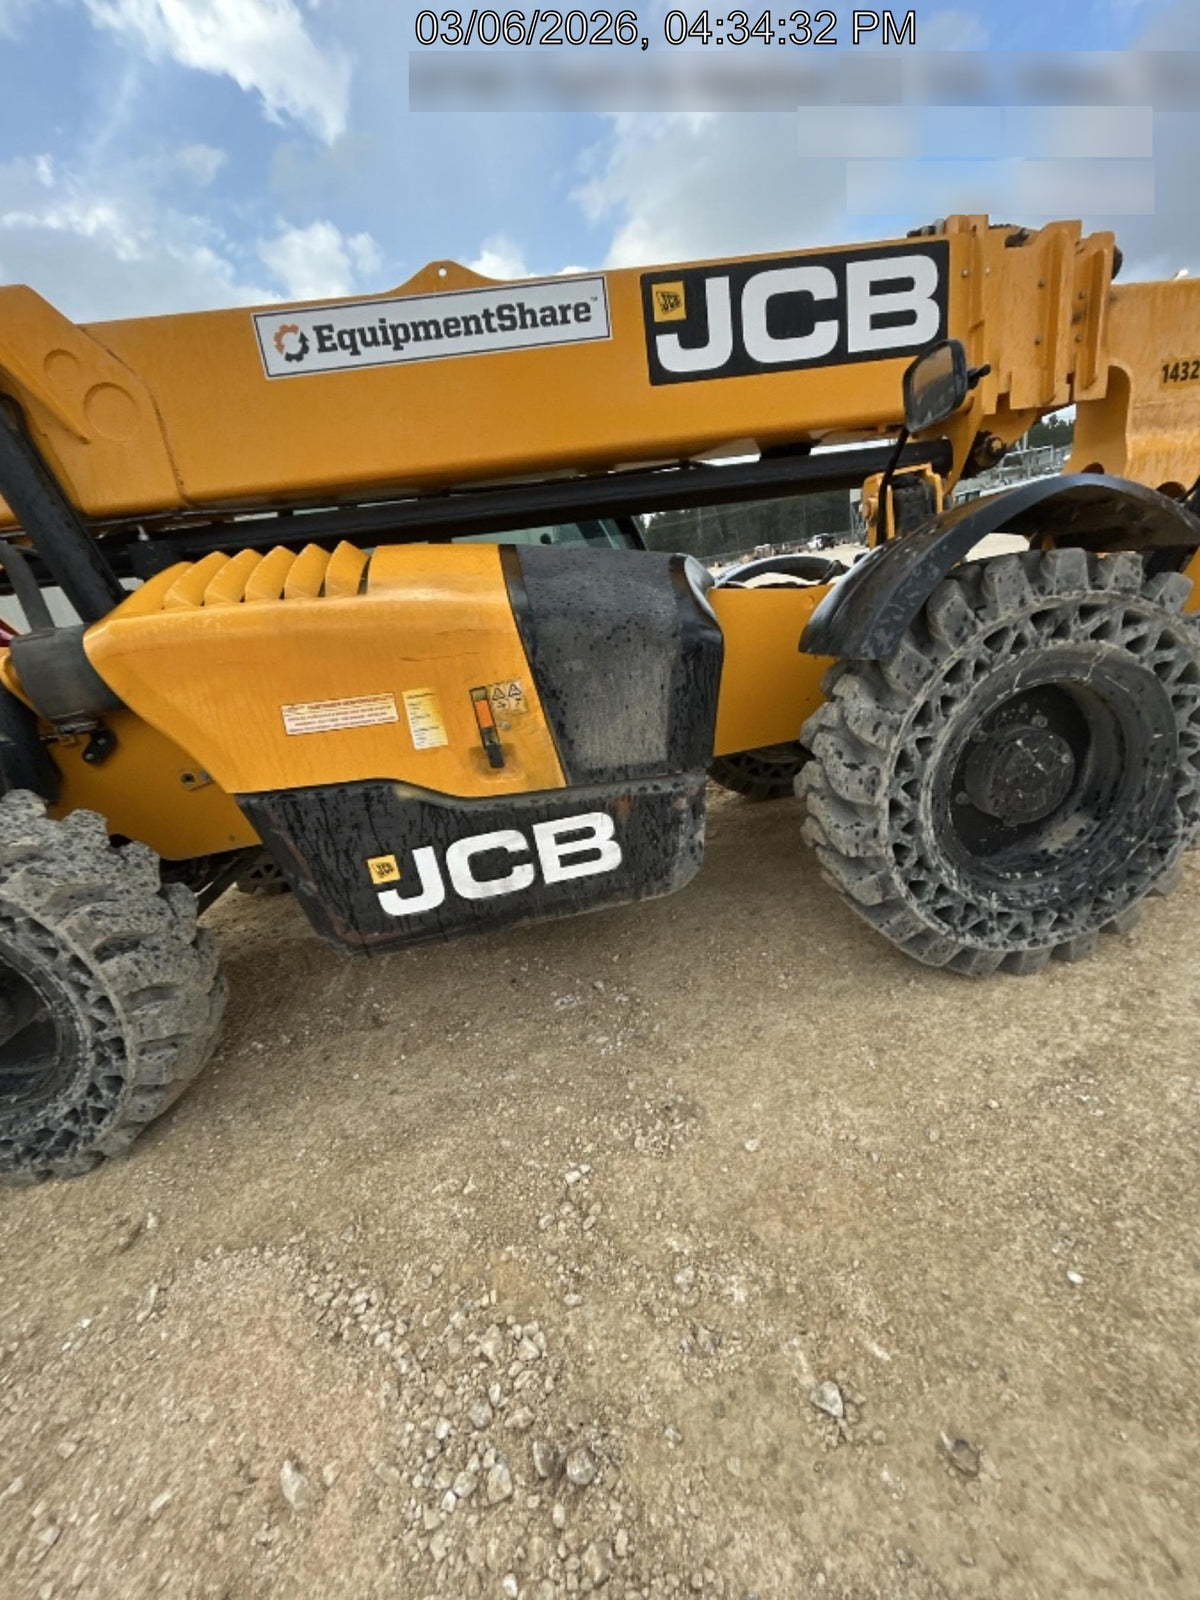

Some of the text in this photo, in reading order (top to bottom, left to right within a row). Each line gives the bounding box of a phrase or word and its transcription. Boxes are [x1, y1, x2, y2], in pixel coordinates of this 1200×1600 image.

[312, 301, 592, 356] EquipmentShare
[654, 254, 941, 373] JCB
[377, 811, 622, 916] JCB
